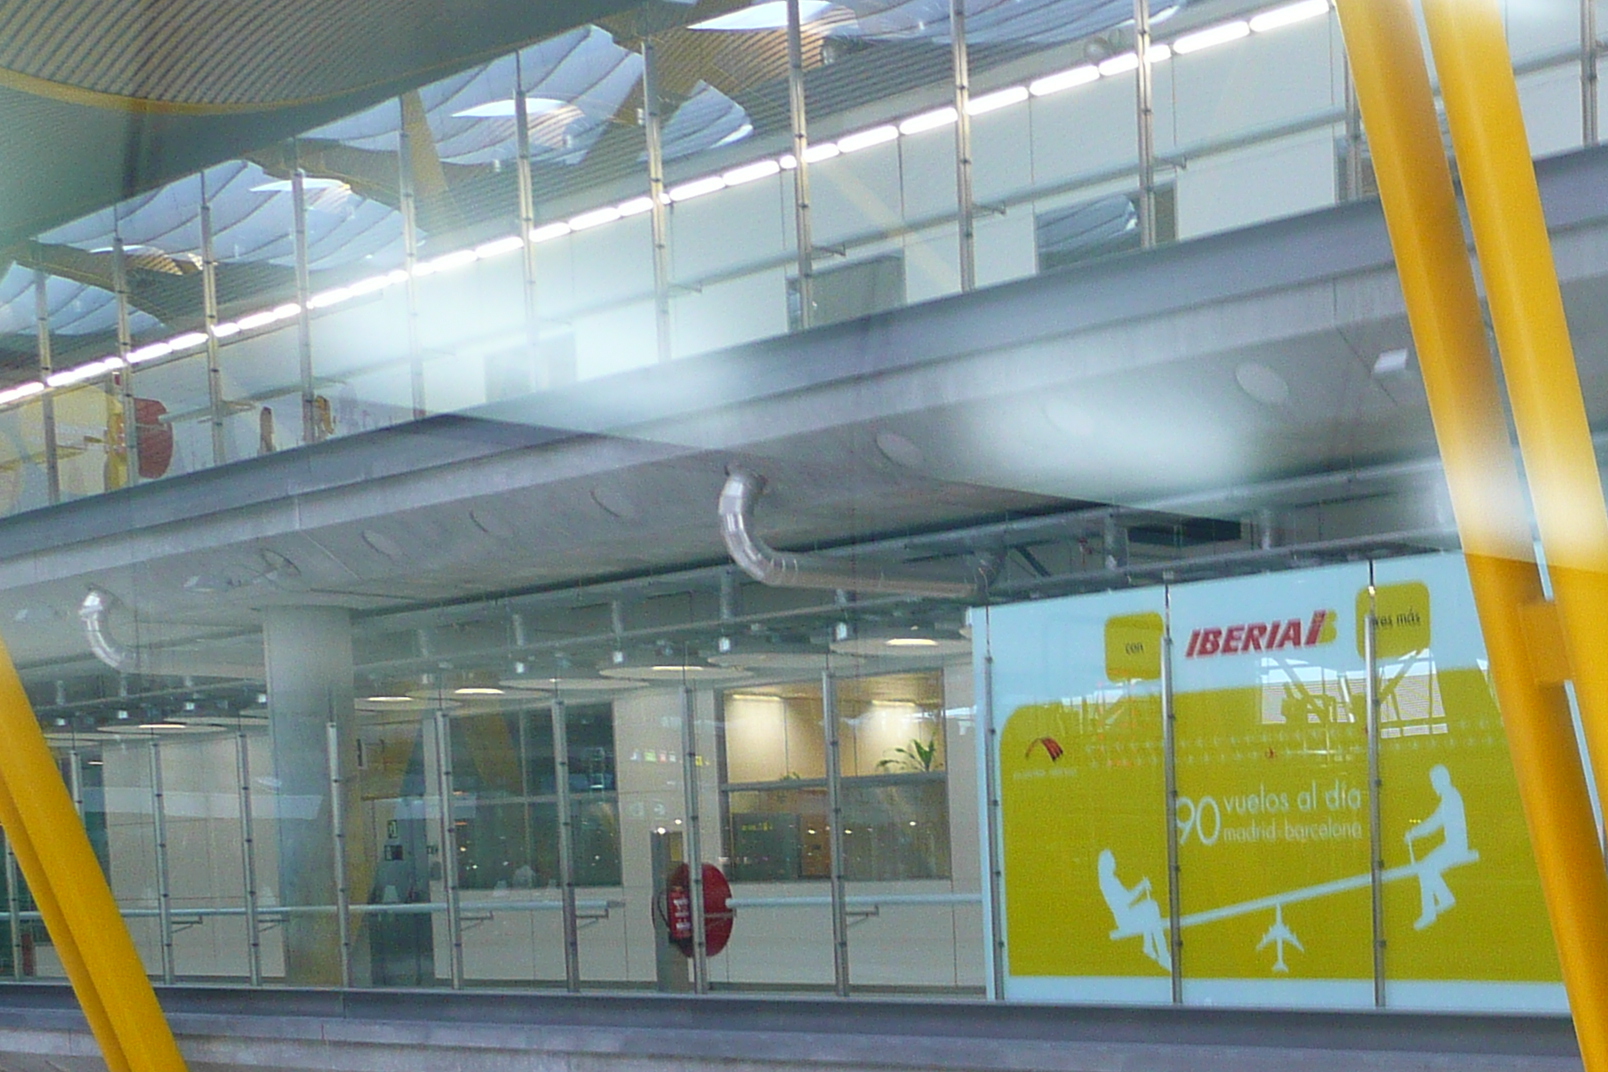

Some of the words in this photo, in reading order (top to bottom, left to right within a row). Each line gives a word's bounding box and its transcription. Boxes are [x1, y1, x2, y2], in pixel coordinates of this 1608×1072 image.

[1185, 617, 1302, 658] IBERIA
[1223, 782, 1289, 814] vuelos
[1298, 780, 1317, 811] al
[1325, 777, 1361, 810] día
[1176, 796, 1221, 845] 90
